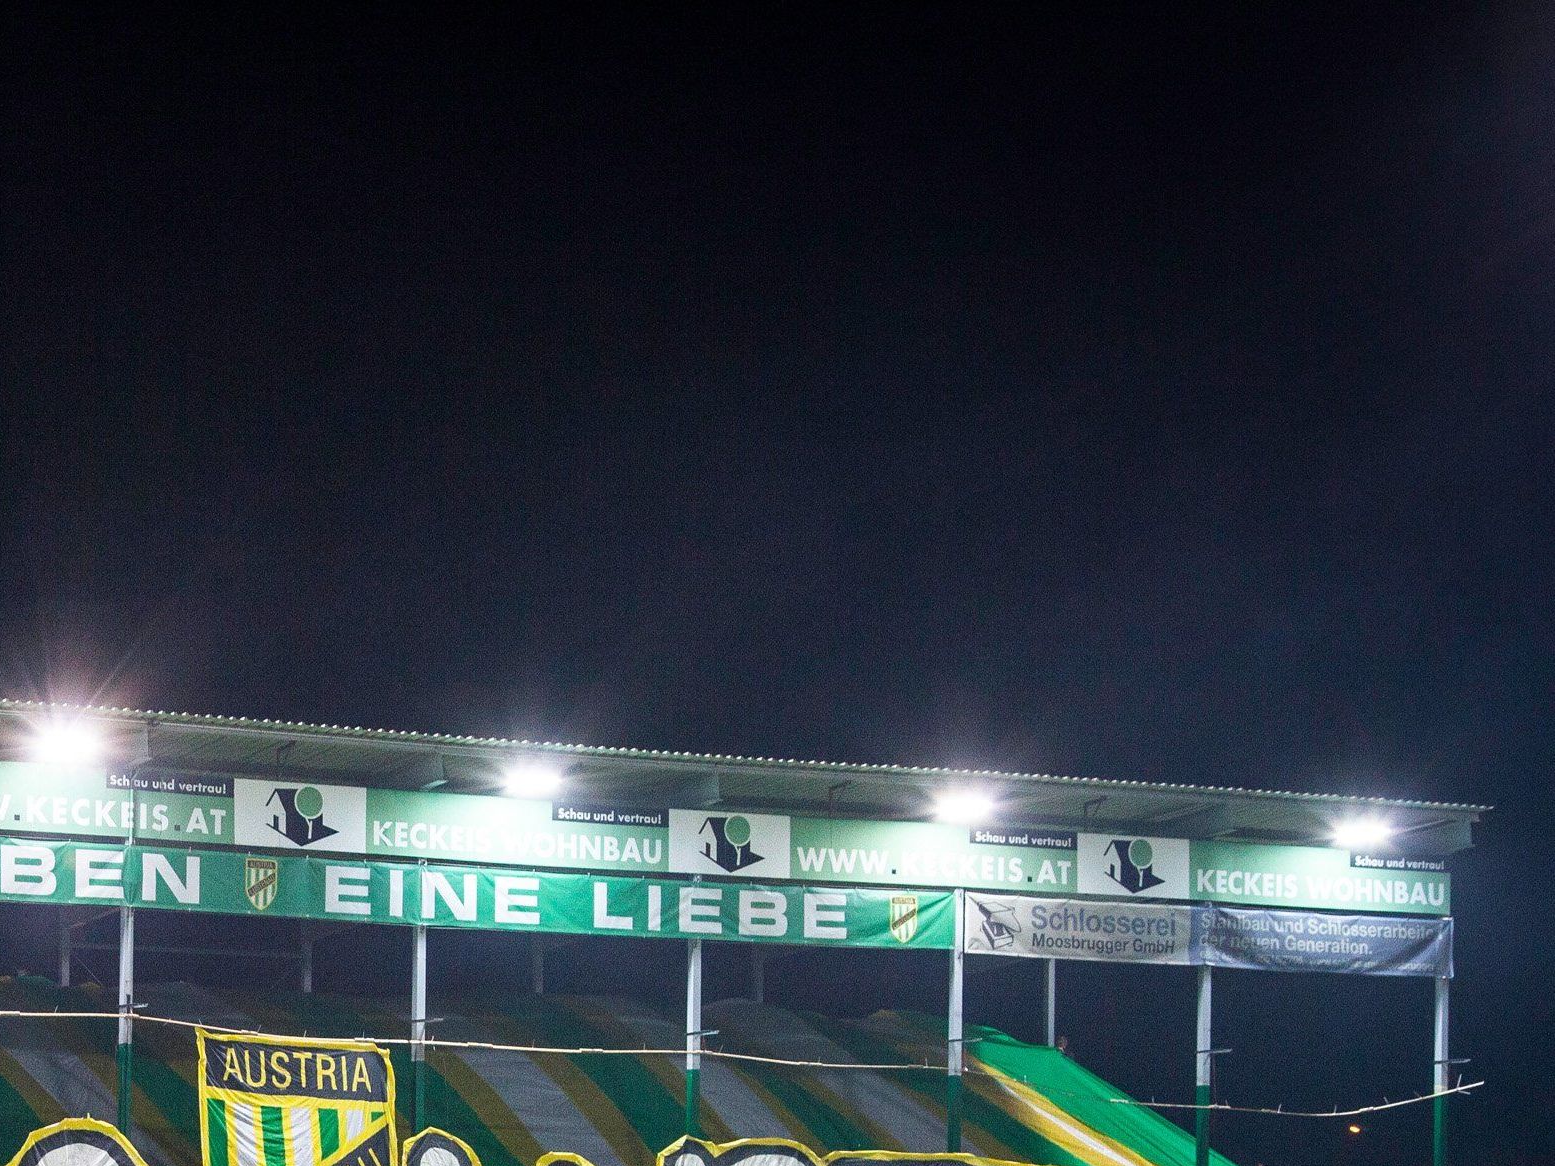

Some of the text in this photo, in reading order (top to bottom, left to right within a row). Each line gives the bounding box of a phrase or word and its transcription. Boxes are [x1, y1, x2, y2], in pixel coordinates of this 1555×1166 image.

[109, 773, 227, 794] Schau und vertrau!
[557, 807, 662, 825] Schau und vertrau!
[373, 820, 492, 854] KECKEIS
[975, 830, 1072, 849] Schau und vertrau!
[1355, 855, 1445, 871] Schau und vertrau!
[1196, 868, 1445, 906] KECKEIS WOHNBAU
[325, 866, 541, 924] EINE
[593, 882, 847, 939] LIEBE
[1031, 905, 1177, 937] Schlosserei
[1274, 917, 1304, 933] und
[1307, 918, 1439, 940] Schlosserarbeite
[1031, 935, 1176, 956] Moosbrugger GmbH
[1284, 935, 1374, 955] Generation.
[223, 1047, 372, 1093] AUSTRIA
